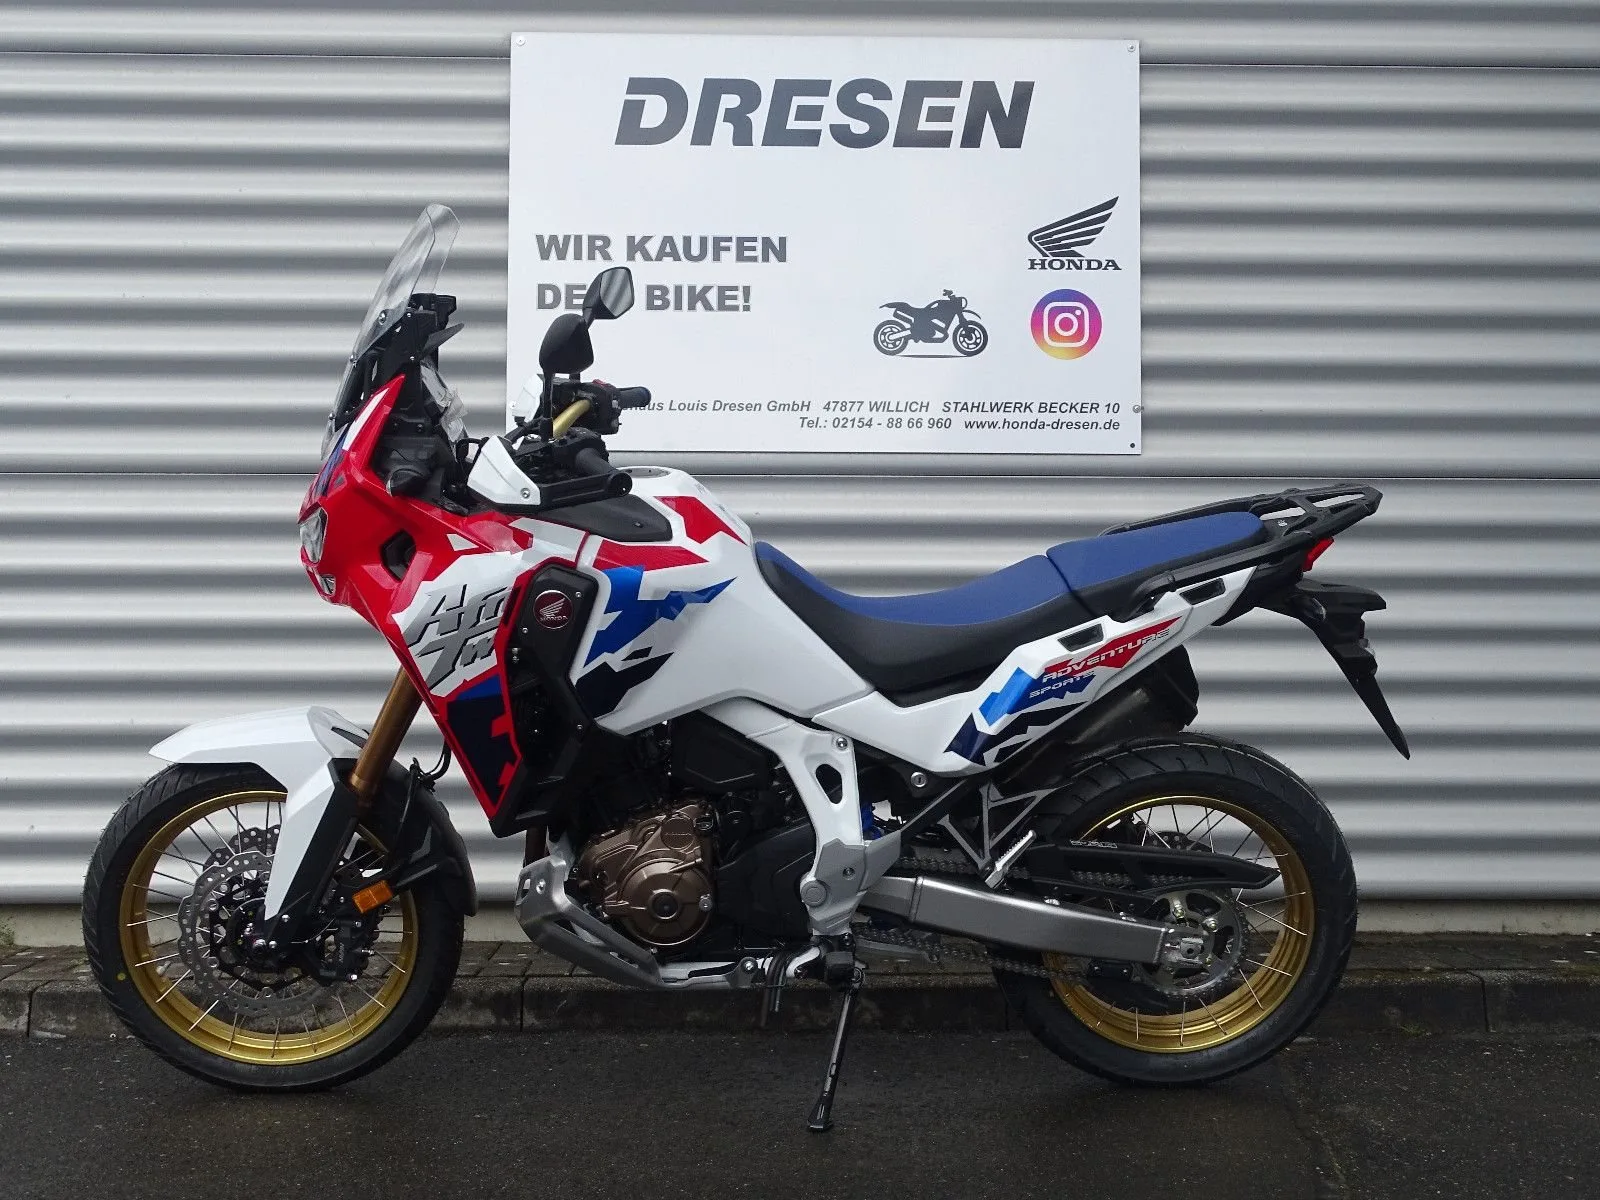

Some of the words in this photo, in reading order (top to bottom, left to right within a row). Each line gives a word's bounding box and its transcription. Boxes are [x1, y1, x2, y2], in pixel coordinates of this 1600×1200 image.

[615, 77, 1035, 149] DRESEN
[535, 234, 613, 261] WIR
[625, 235, 787, 263] KAUFEN
[1028, 257, 1122, 271] HONDA
[537, 283, 587, 311] DE
[645, 284, 751, 312] BIKE!
[668, 399, 708, 412] Louis
[712, 399, 762, 412] Dresen
[766, 400, 812, 413] GmbH
[822, 400, 866, 413] 47877
[869, 400, 930, 413] WILLICH
[941, 401, 1035, 414] STAHLWERK
[1037, 402, 1100, 414] BECKER
[1104, 402, 1121, 414] 10
[799, 416, 828, 429] Tel.:
[832, 416, 873, 429] 02154
[886, 417, 903, 429] 88
[907, 417, 924, 429] 66
[927, 417, 952, 430] 960
[964, 417, 1121, 431] www.honda-dresen.de
[1042, 628, 1170, 684] ADVENTURE
[1029, 670, 1096, 699] SPORTS
